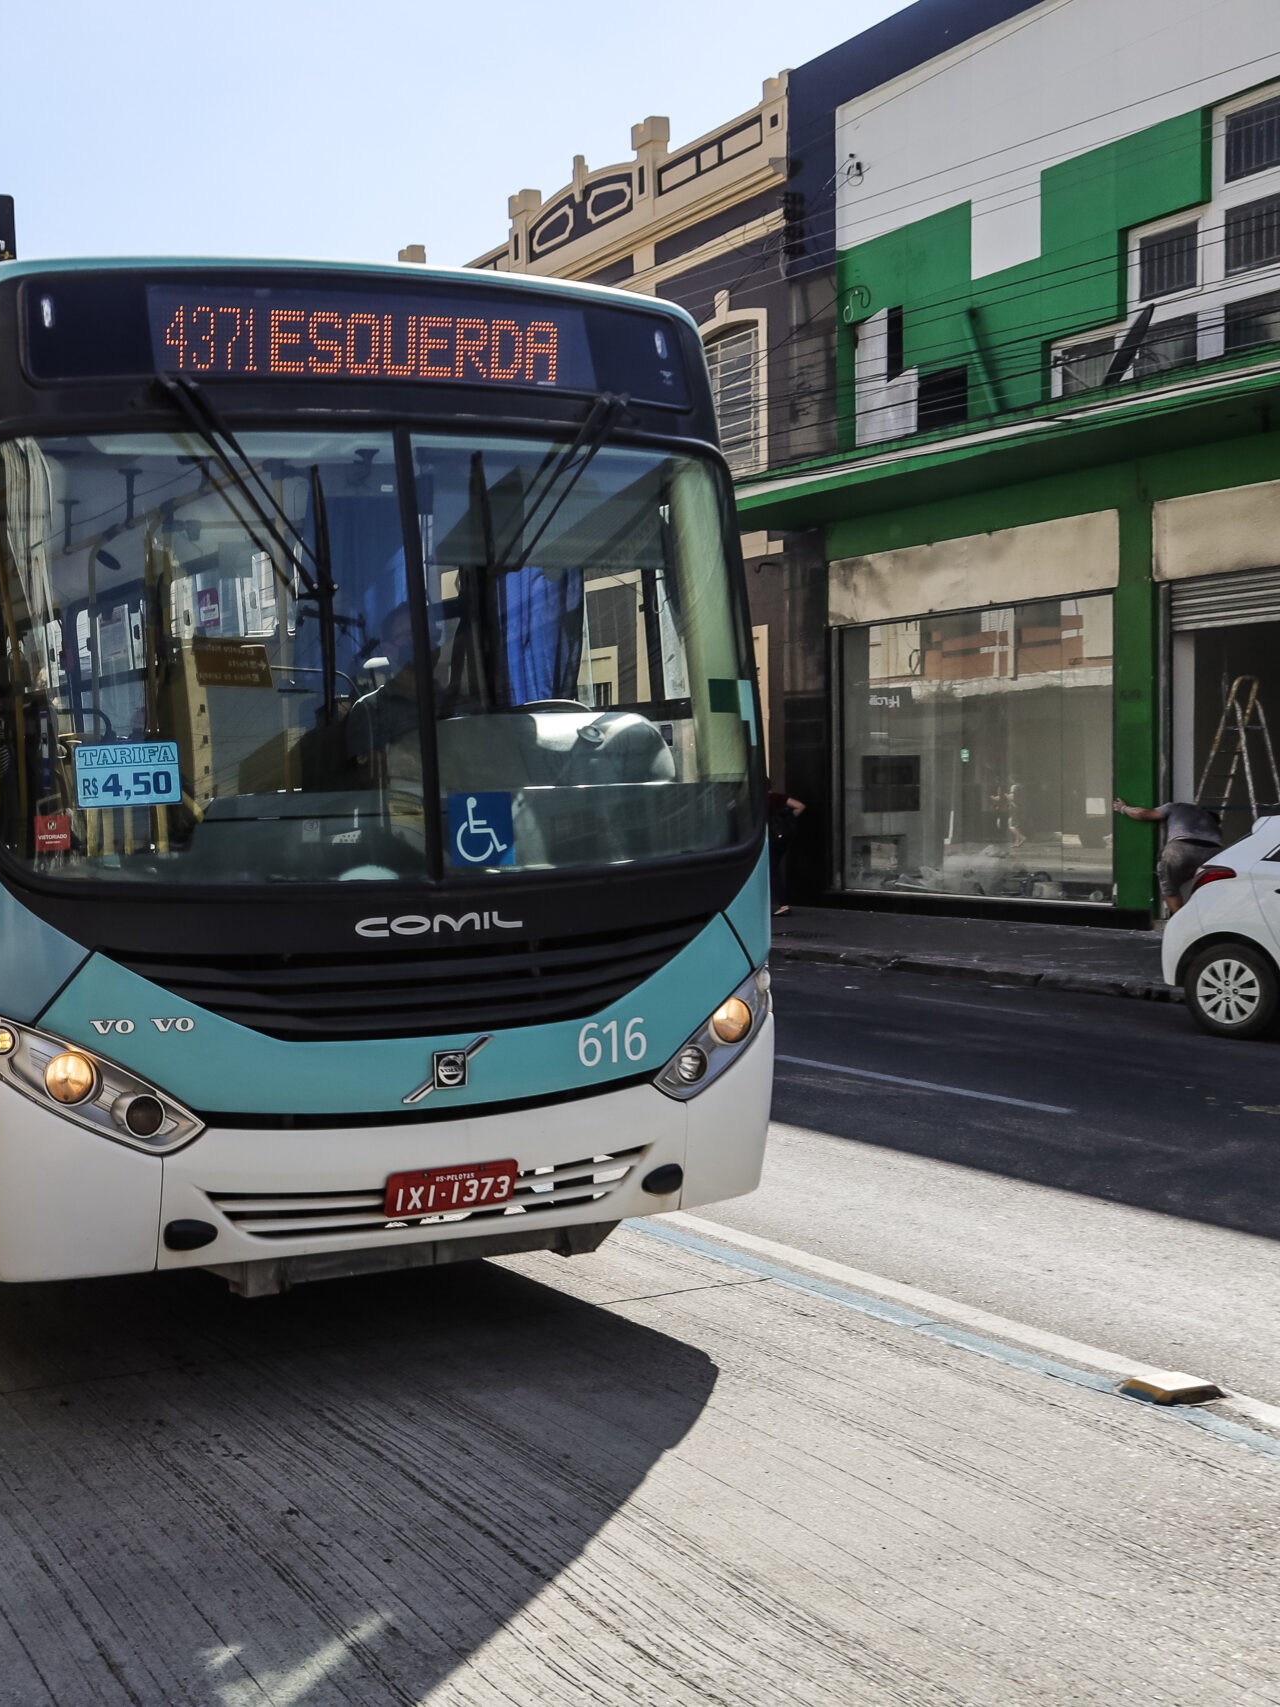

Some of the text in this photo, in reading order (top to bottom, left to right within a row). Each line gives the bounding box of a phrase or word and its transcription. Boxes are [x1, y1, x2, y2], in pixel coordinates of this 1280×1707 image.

[165, 305, 558, 382] 4371 ESQUERDA
[78, 745, 176, 767] TARIFA
[83, 771, 172, 800] R$ 4,50
[355, 911, 523, 938] COMIL
[89, 1017, 195, 1035] VO VO
[578, 1017, 648, 1067] 616
